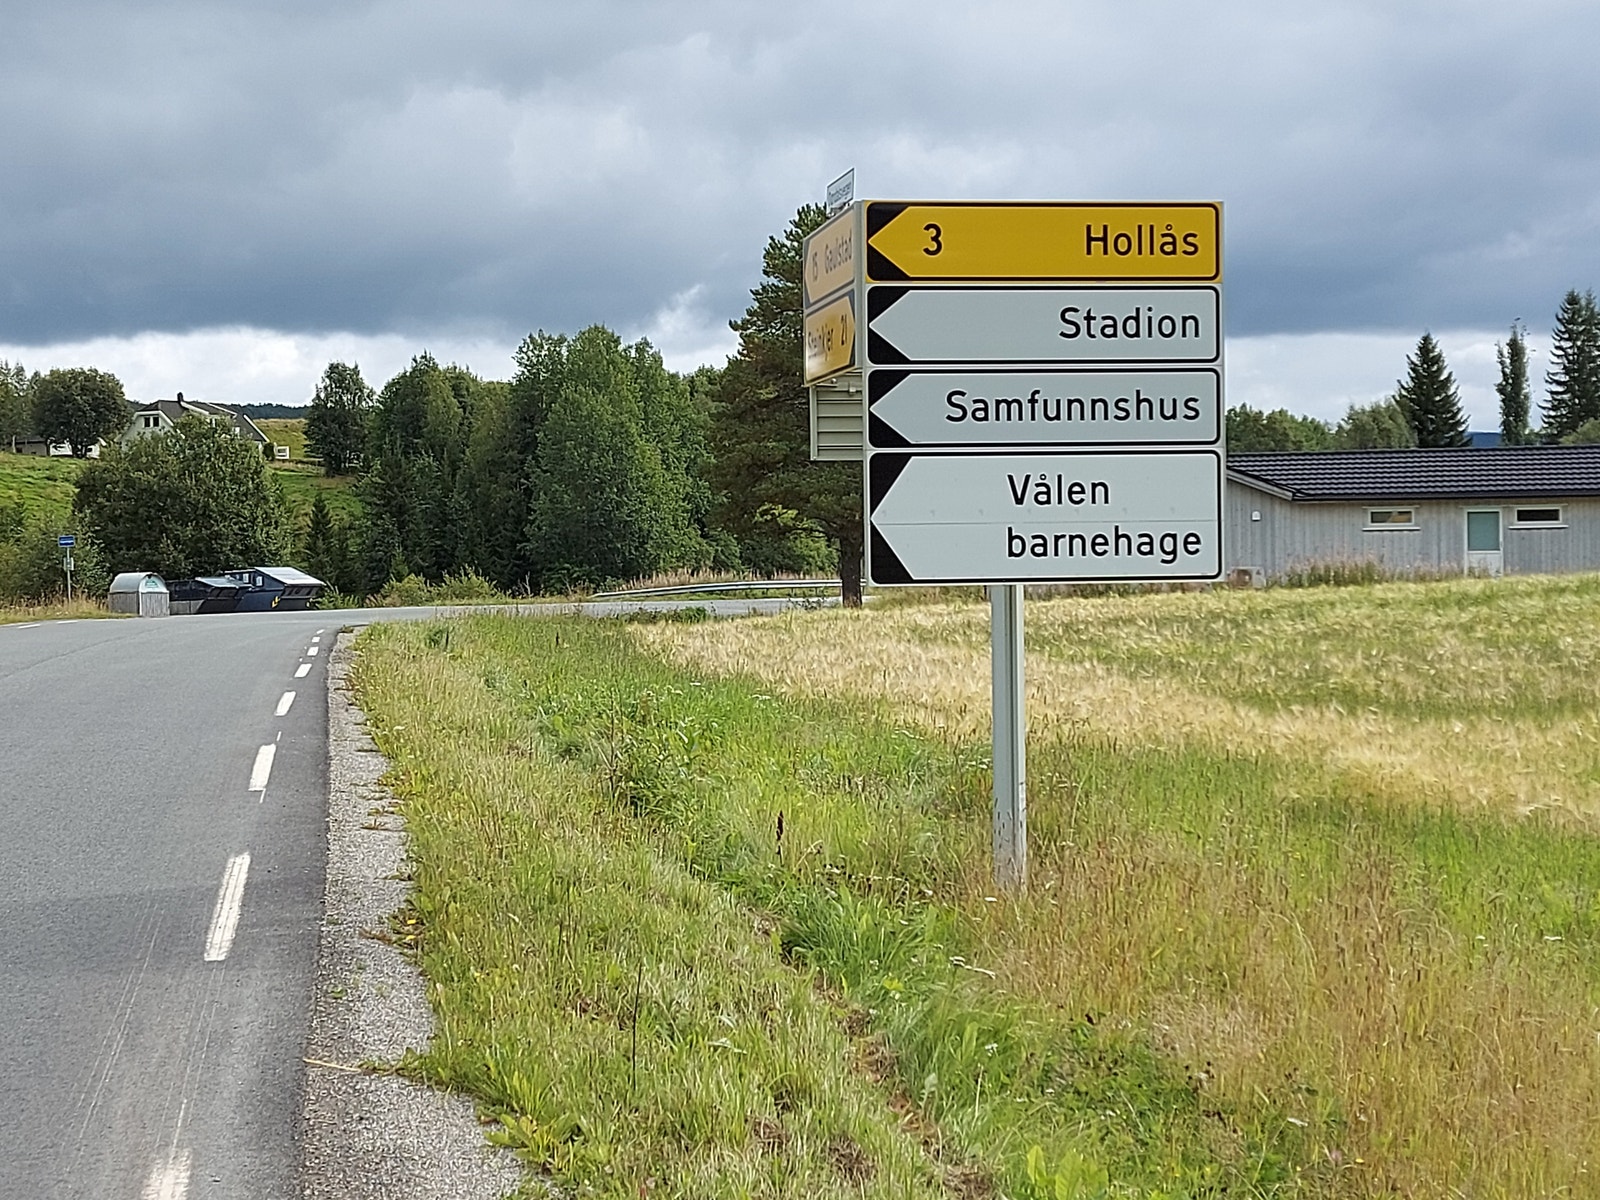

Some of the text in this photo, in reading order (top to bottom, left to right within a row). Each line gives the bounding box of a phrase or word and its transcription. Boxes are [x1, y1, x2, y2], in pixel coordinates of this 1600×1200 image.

[922, 223, 1199, 256] 3 Hollås
[840, 313, 848, 346] 21
[1058, 306, 1200, 339] Stadion
[945, 389, 1200, 423] Samfunnshus
[1007, 473, 1109, 506] Vålen
[1007, 525, 1202, 565] barnehage
